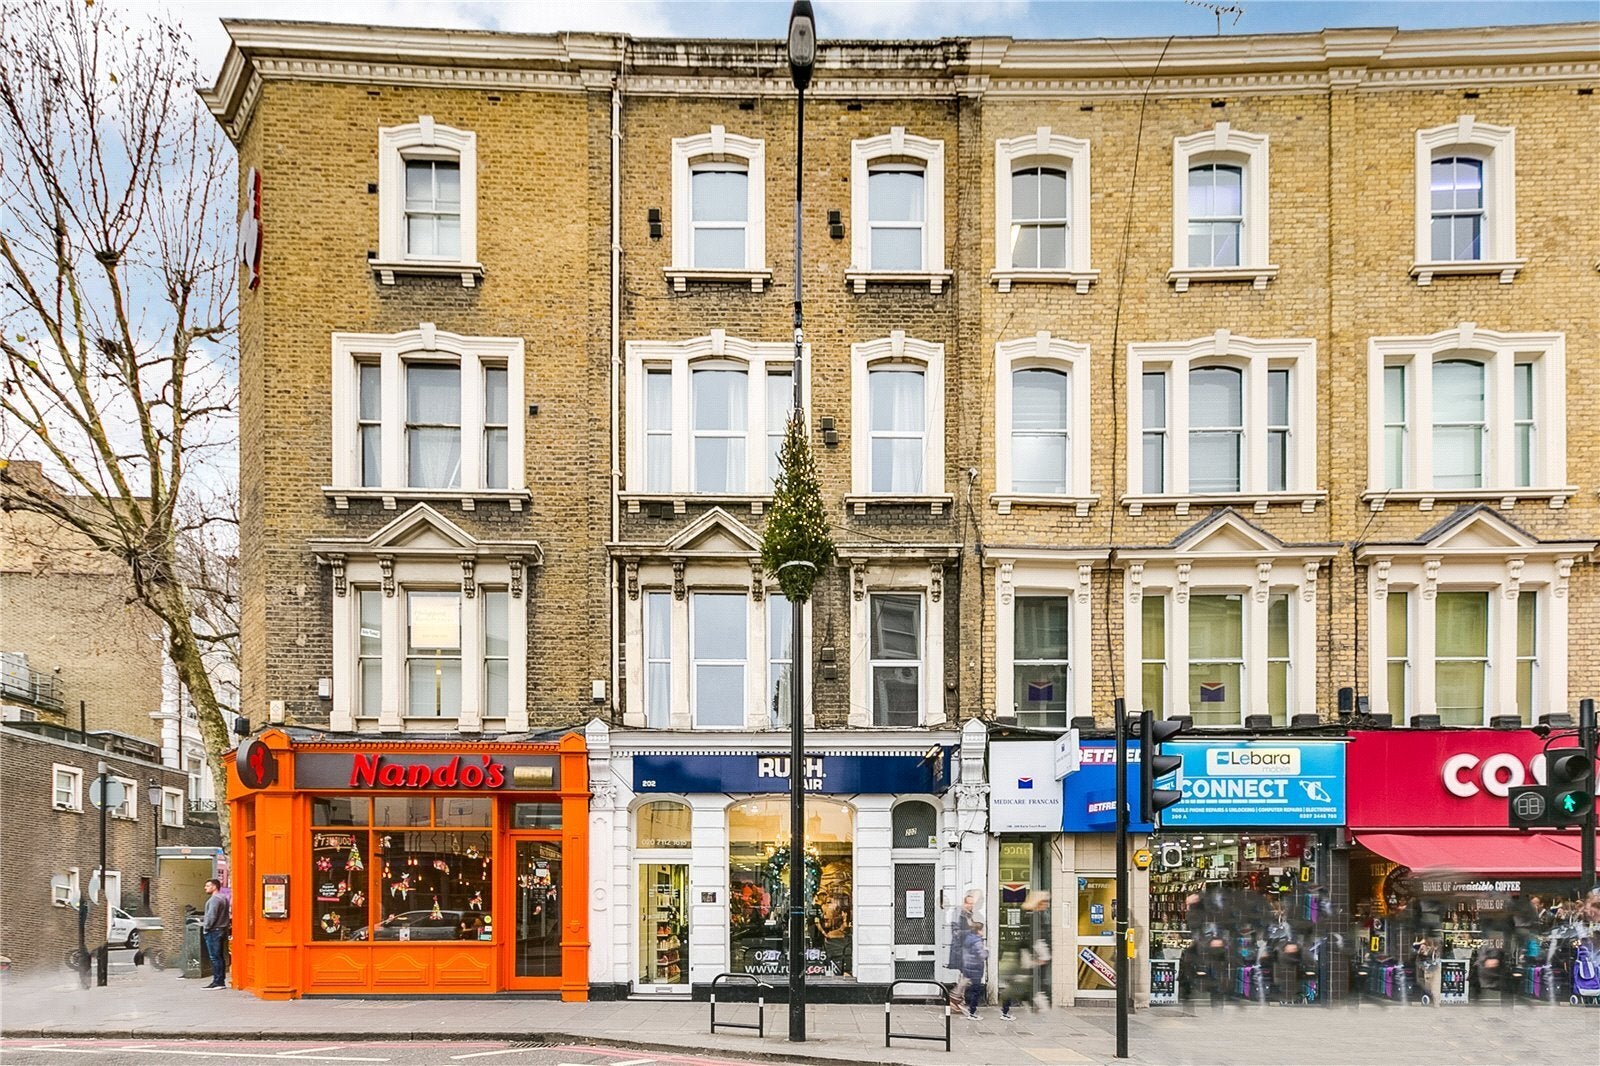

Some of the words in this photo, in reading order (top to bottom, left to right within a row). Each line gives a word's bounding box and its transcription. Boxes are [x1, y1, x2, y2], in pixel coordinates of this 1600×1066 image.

[1231, 751, 1291, 765] Lebara
[349, 753, 505, 788] Nando's
[758, 758, 827, 778] RUH.
[642, 780, 656, 788] 202
[788, 779, 823, 790] AIR
[1182, 779, 1289, 798] CONNECT
[1088, 801, 1131, 814] BETFRE
[1495, 881, 1521, 892] COFFEE
[744, 961, 840, 974] www.ru.co.uk
